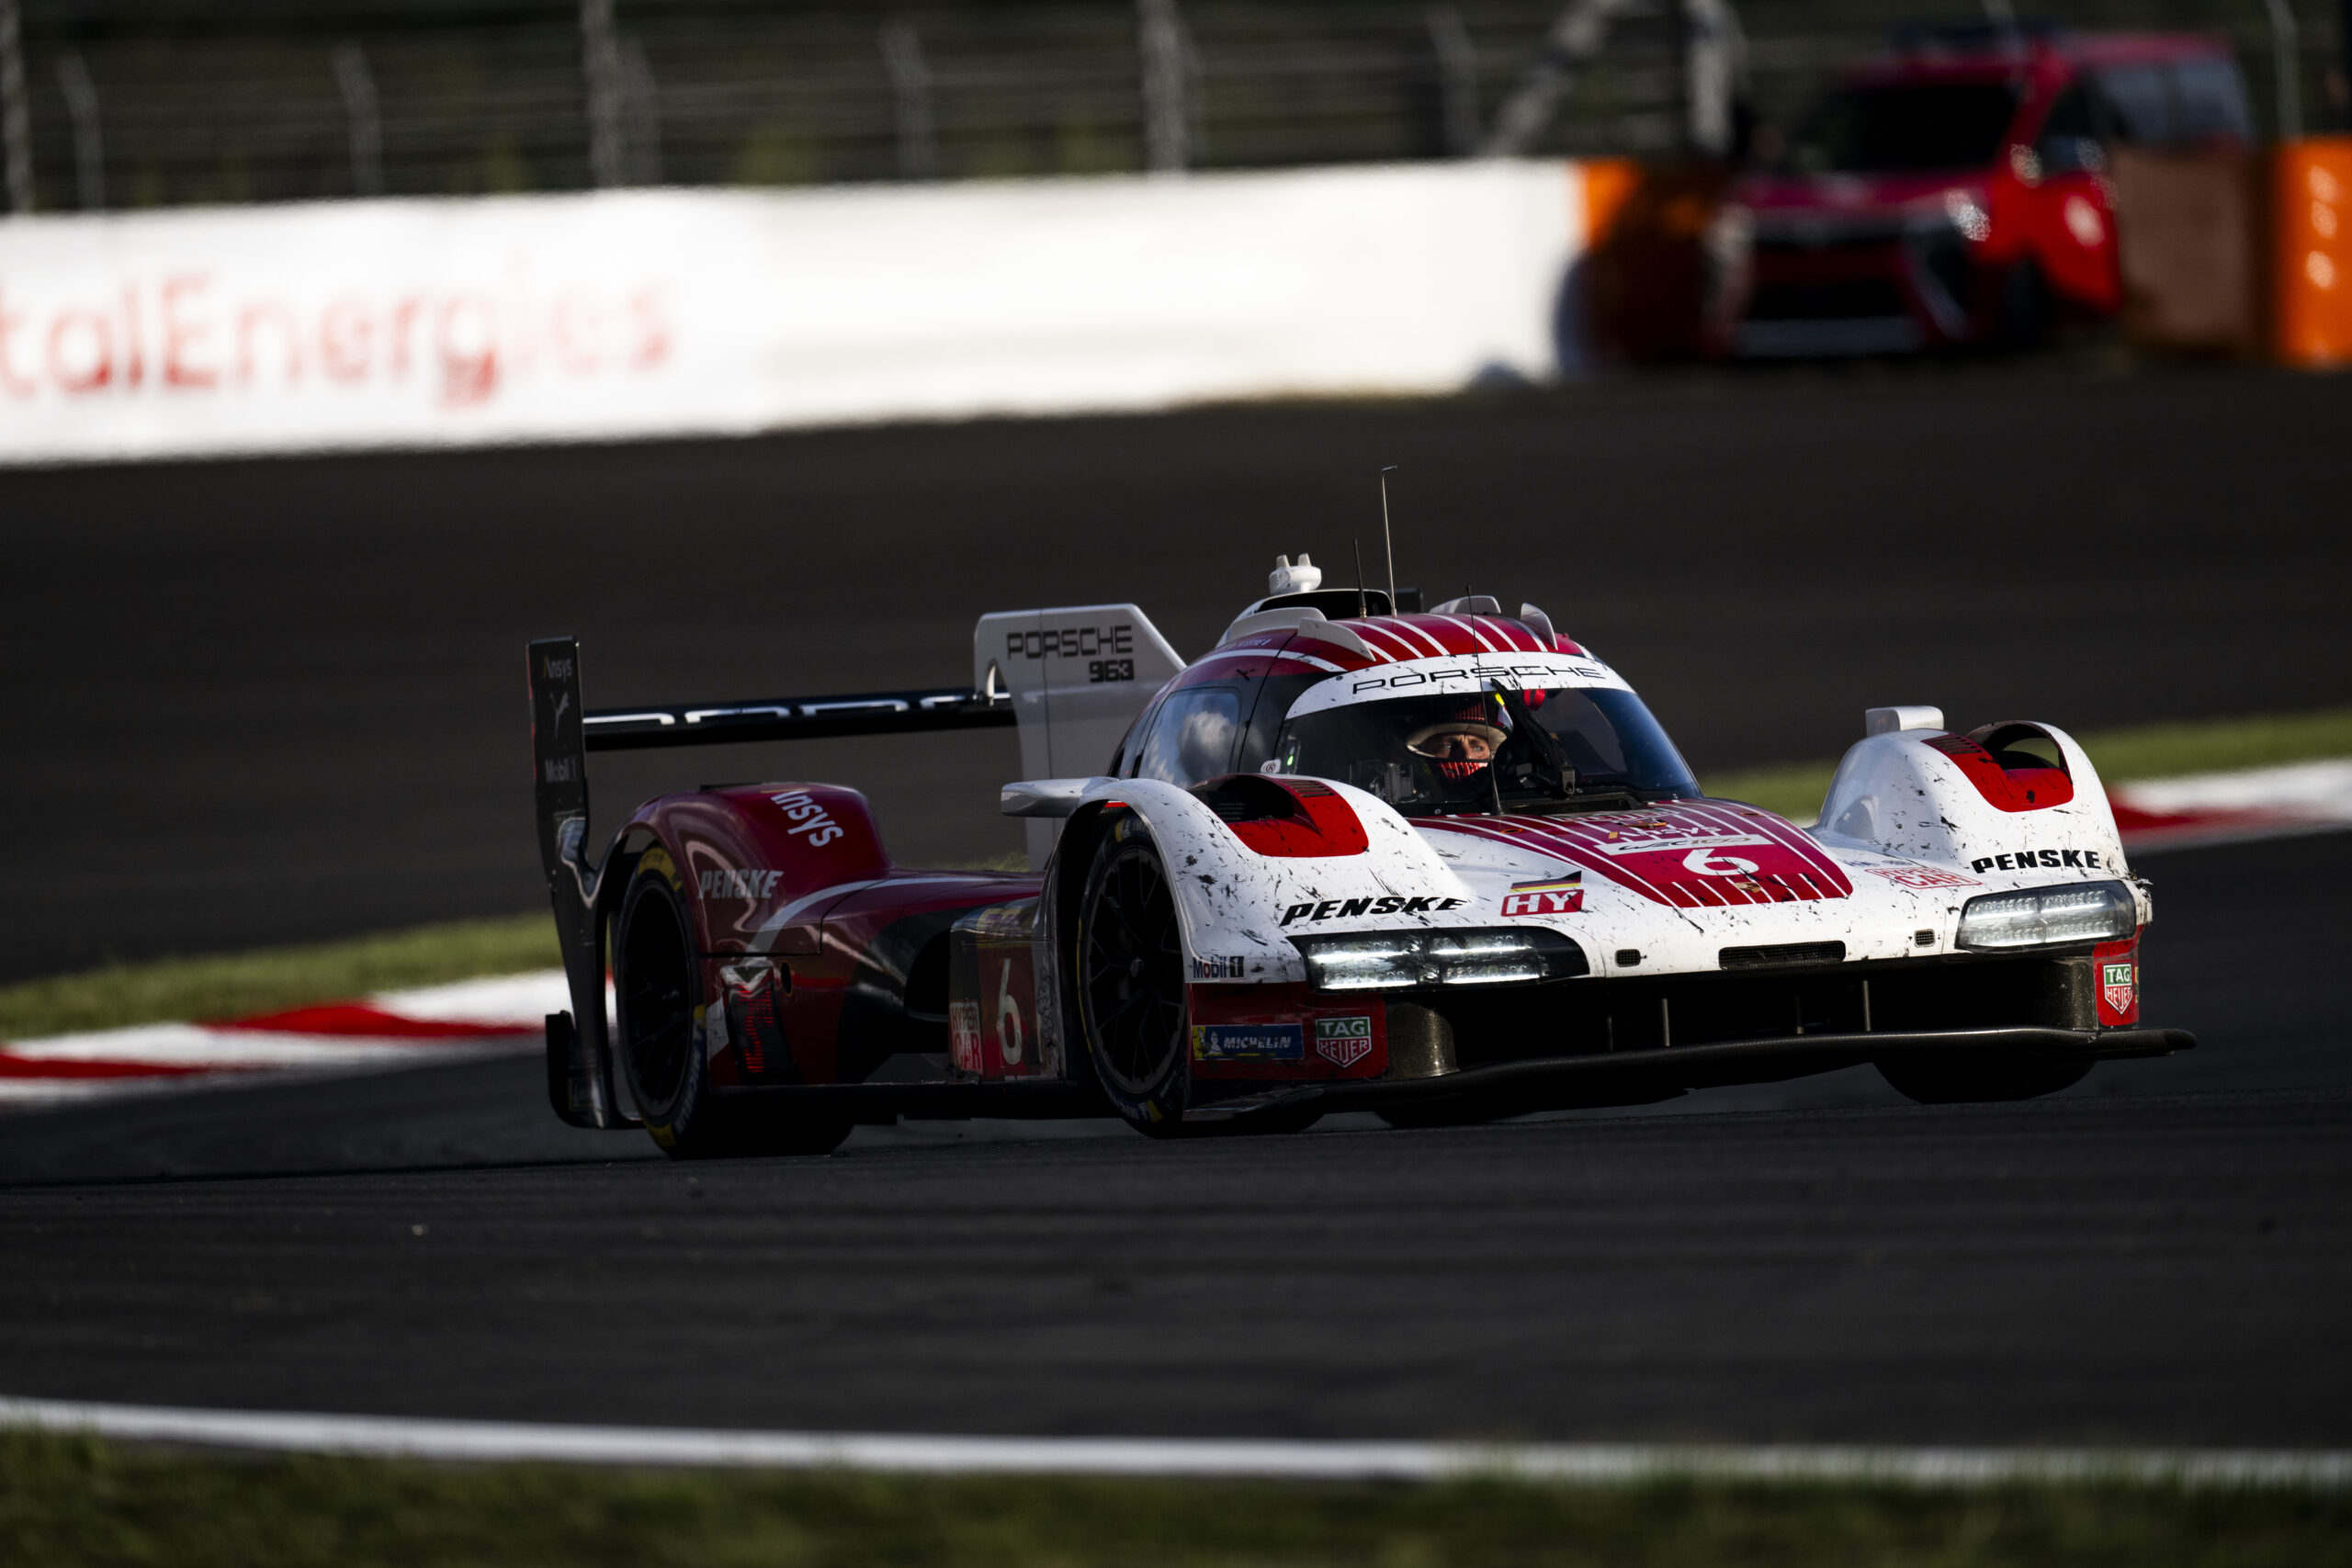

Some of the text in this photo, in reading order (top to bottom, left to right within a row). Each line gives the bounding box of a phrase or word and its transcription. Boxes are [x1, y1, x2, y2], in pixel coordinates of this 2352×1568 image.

[1007, 626, 1133, 660] PORSCHE
[1089, 659, 1135, 682] 963
[1351, 664, 1606, 695] PORSCHE
[1682, 848, 1759, 876] 6
[1972, 849, 2102, 874] PENSKE
[698, 870, 785, 899] PENSKE
[1894, 874, 1972, 887] CAR
[1280, 897, 1468, 926] PENSKE
[1505, 892, 1581, 916] HY
[1193, 956, 1227, 979] Mobil
[2106, 967, 2132, 984] TAG
[952, 1006, 978, 1031] HYPER
[997, 958, 1023, 1066] 6
[1320, 1021, 1366, 1036] TAG
[954, 1031, 983, 1075] CAR
[1223, 1035, 1292, 1050] MICHELIN
[1319, 1038, 1368, 1063] HEUER
